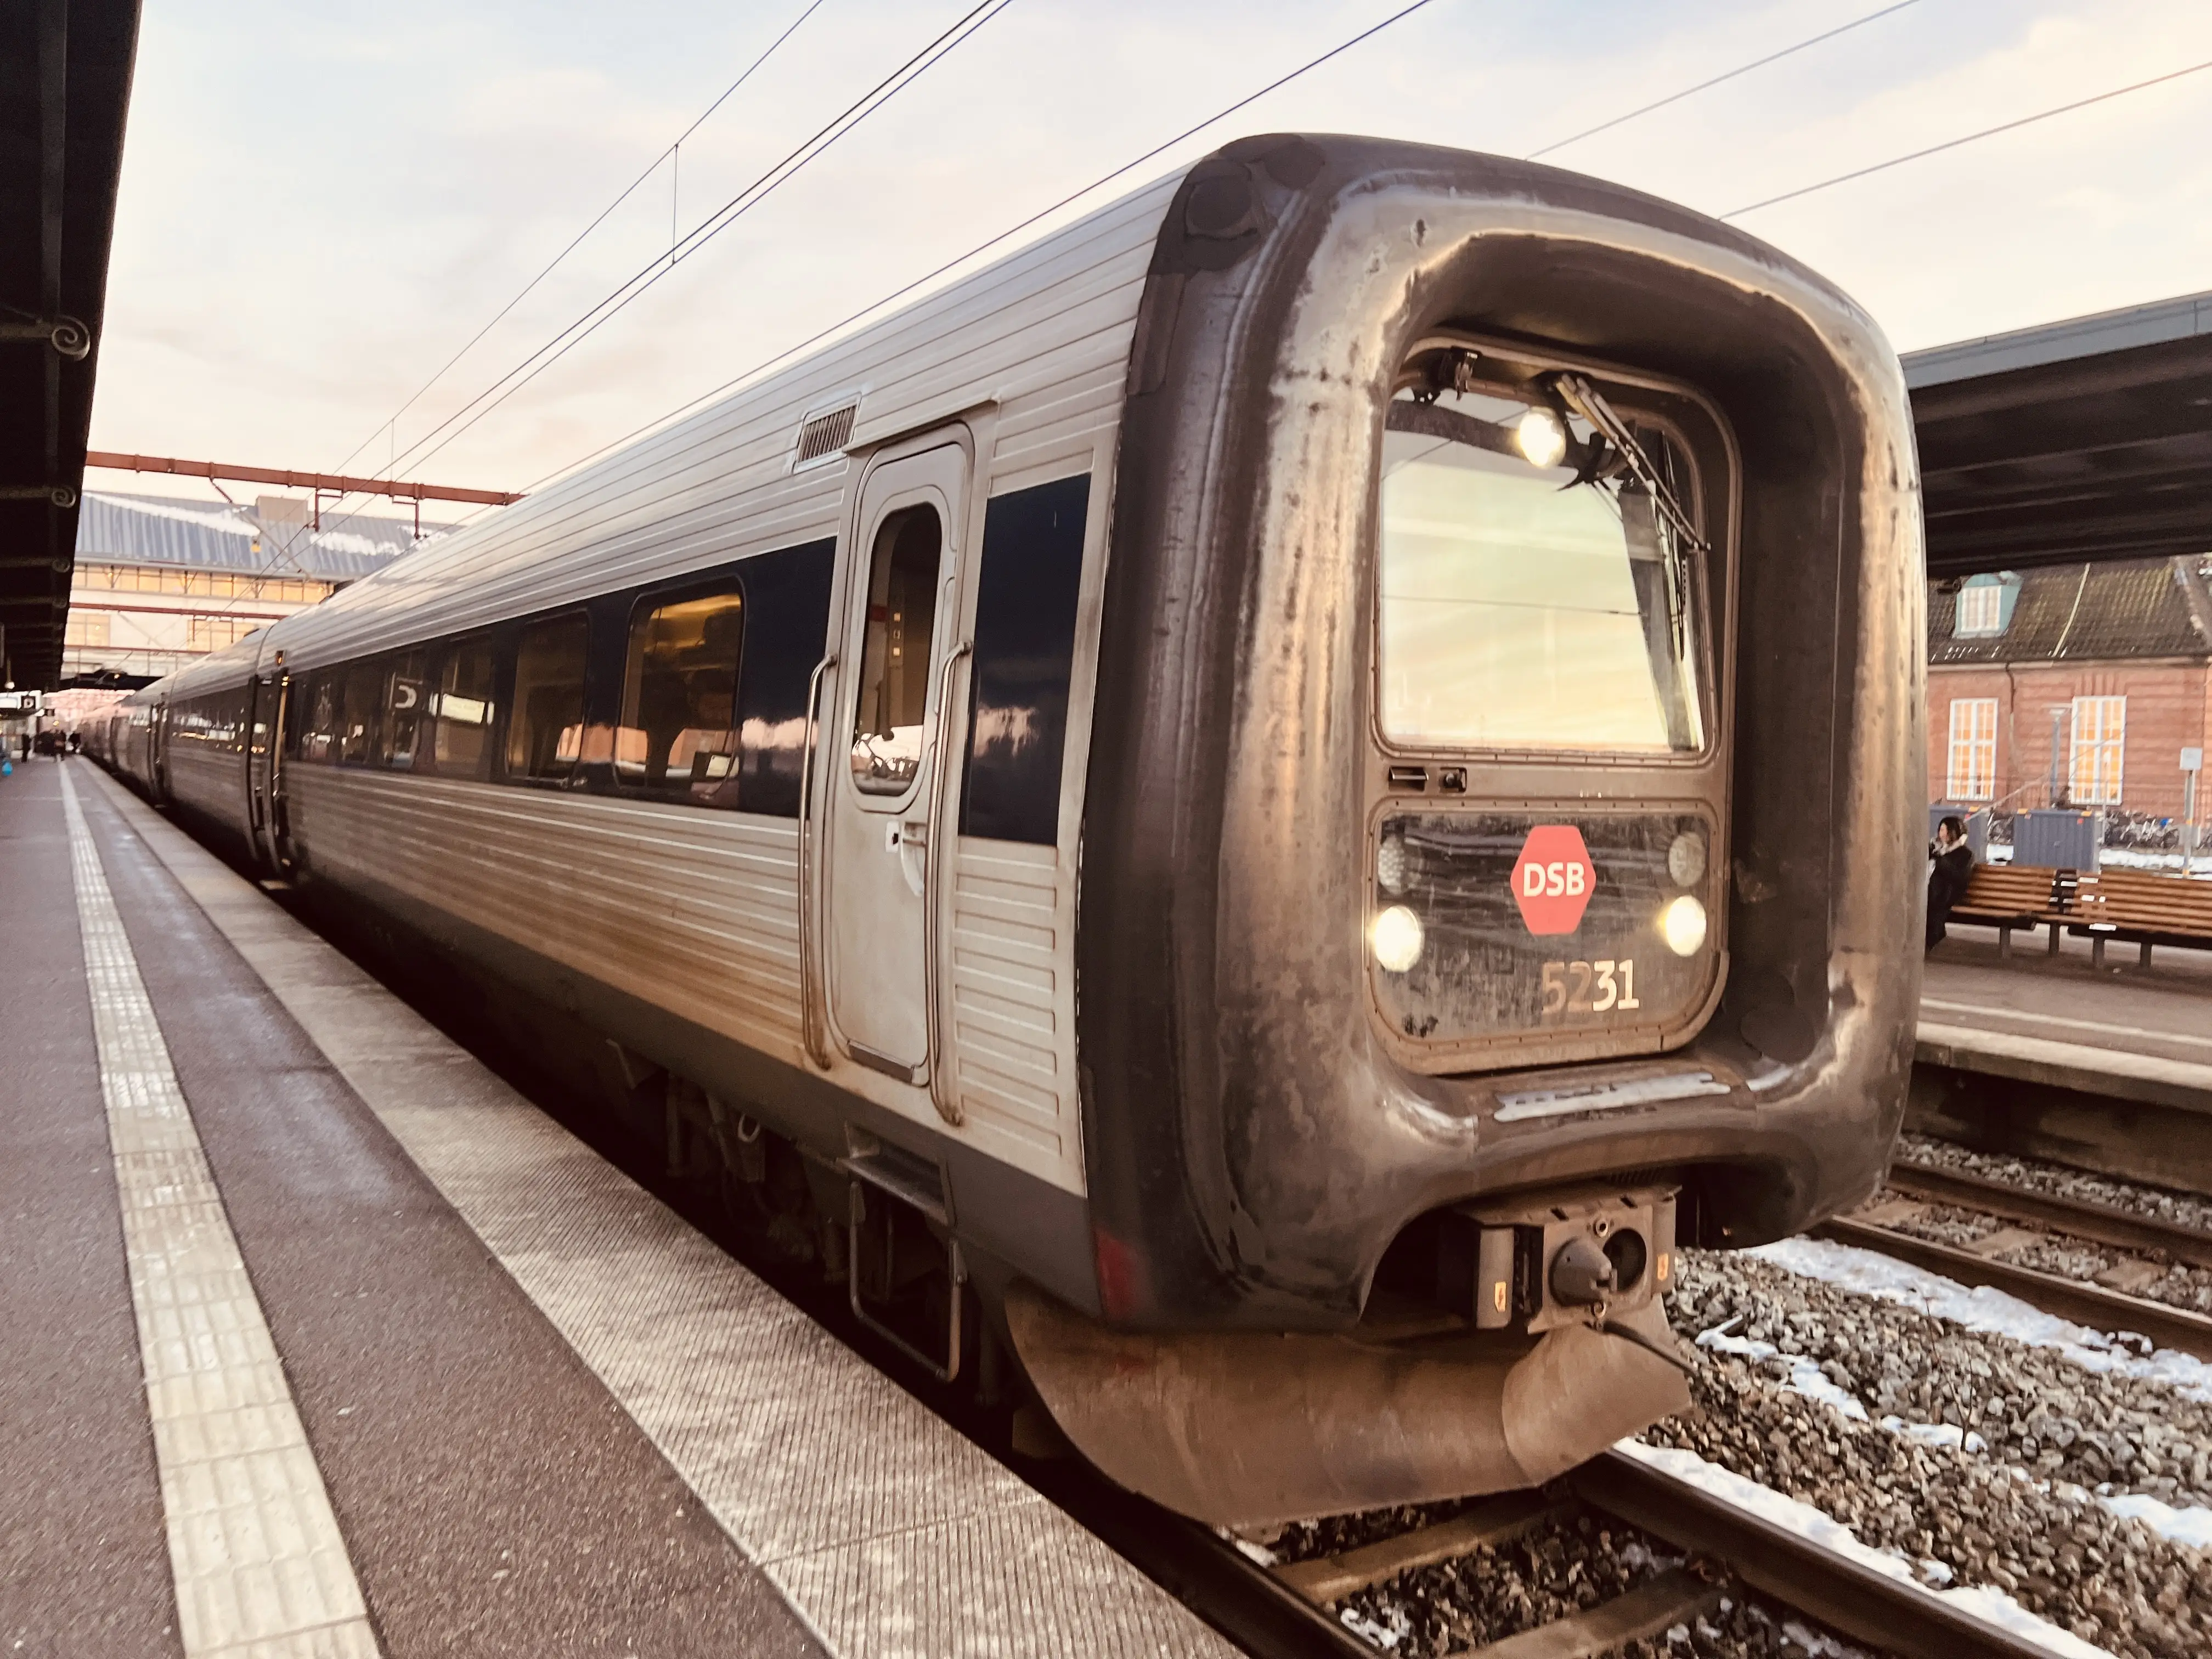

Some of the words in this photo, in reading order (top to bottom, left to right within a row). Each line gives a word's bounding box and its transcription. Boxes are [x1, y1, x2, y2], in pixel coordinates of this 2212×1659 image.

[24, 698, 34, 708] D
[1523, 862, 1585, 897] DSB
[1542, 959, 1640, 1013] 5231
